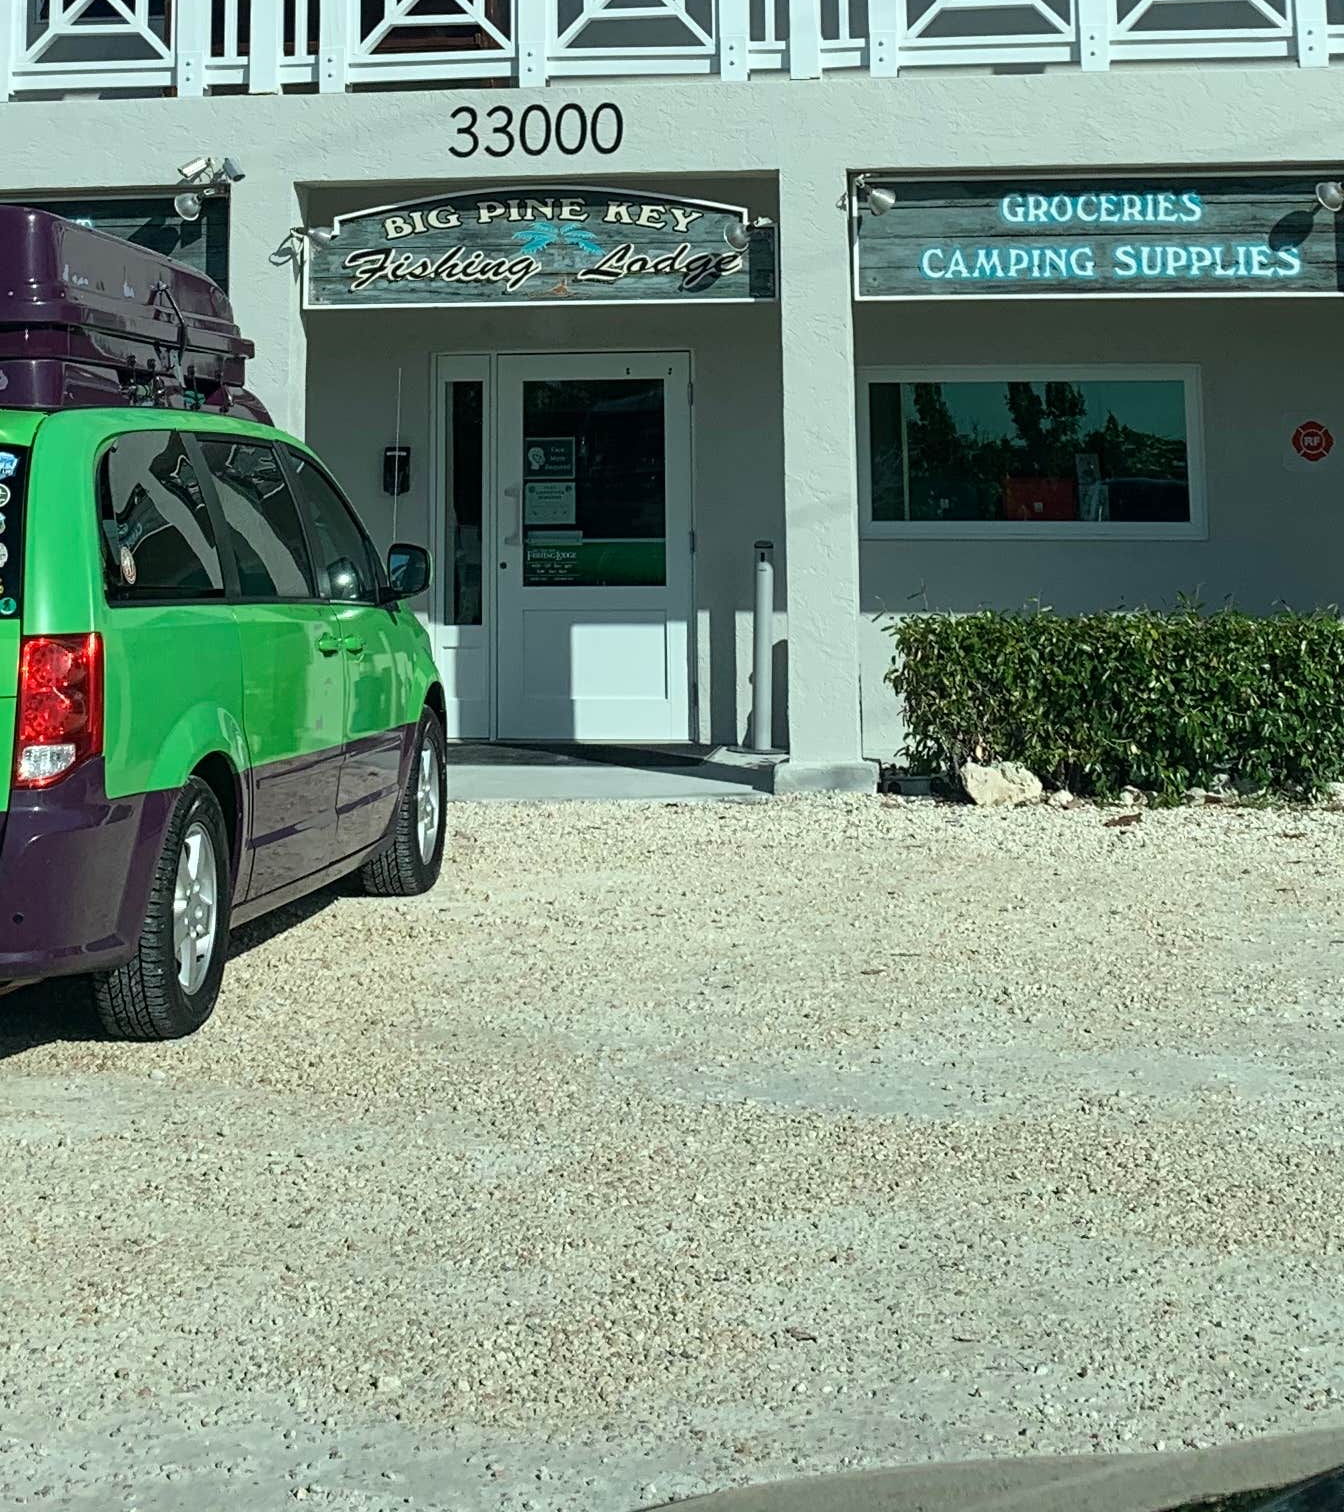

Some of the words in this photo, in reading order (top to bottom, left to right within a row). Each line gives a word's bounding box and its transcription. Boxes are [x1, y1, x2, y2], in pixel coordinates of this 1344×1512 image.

[448, 102, 623, 158] 33000
[383, 205, 463, 240] BIG
[477, 197, 590, 224] PINE
[604, 200, 704, 233] KEY
[1001, 193, 1202, 223] GROCERIES
[342, 246, 543, 292] Fishing
[574, 242, 745, 289] Lodge
[921, 247, 1096, 279] CAMPING
[1114, 245, 1302, 277] SUPPLIES
[1303, 435, 1321, 448] RF
